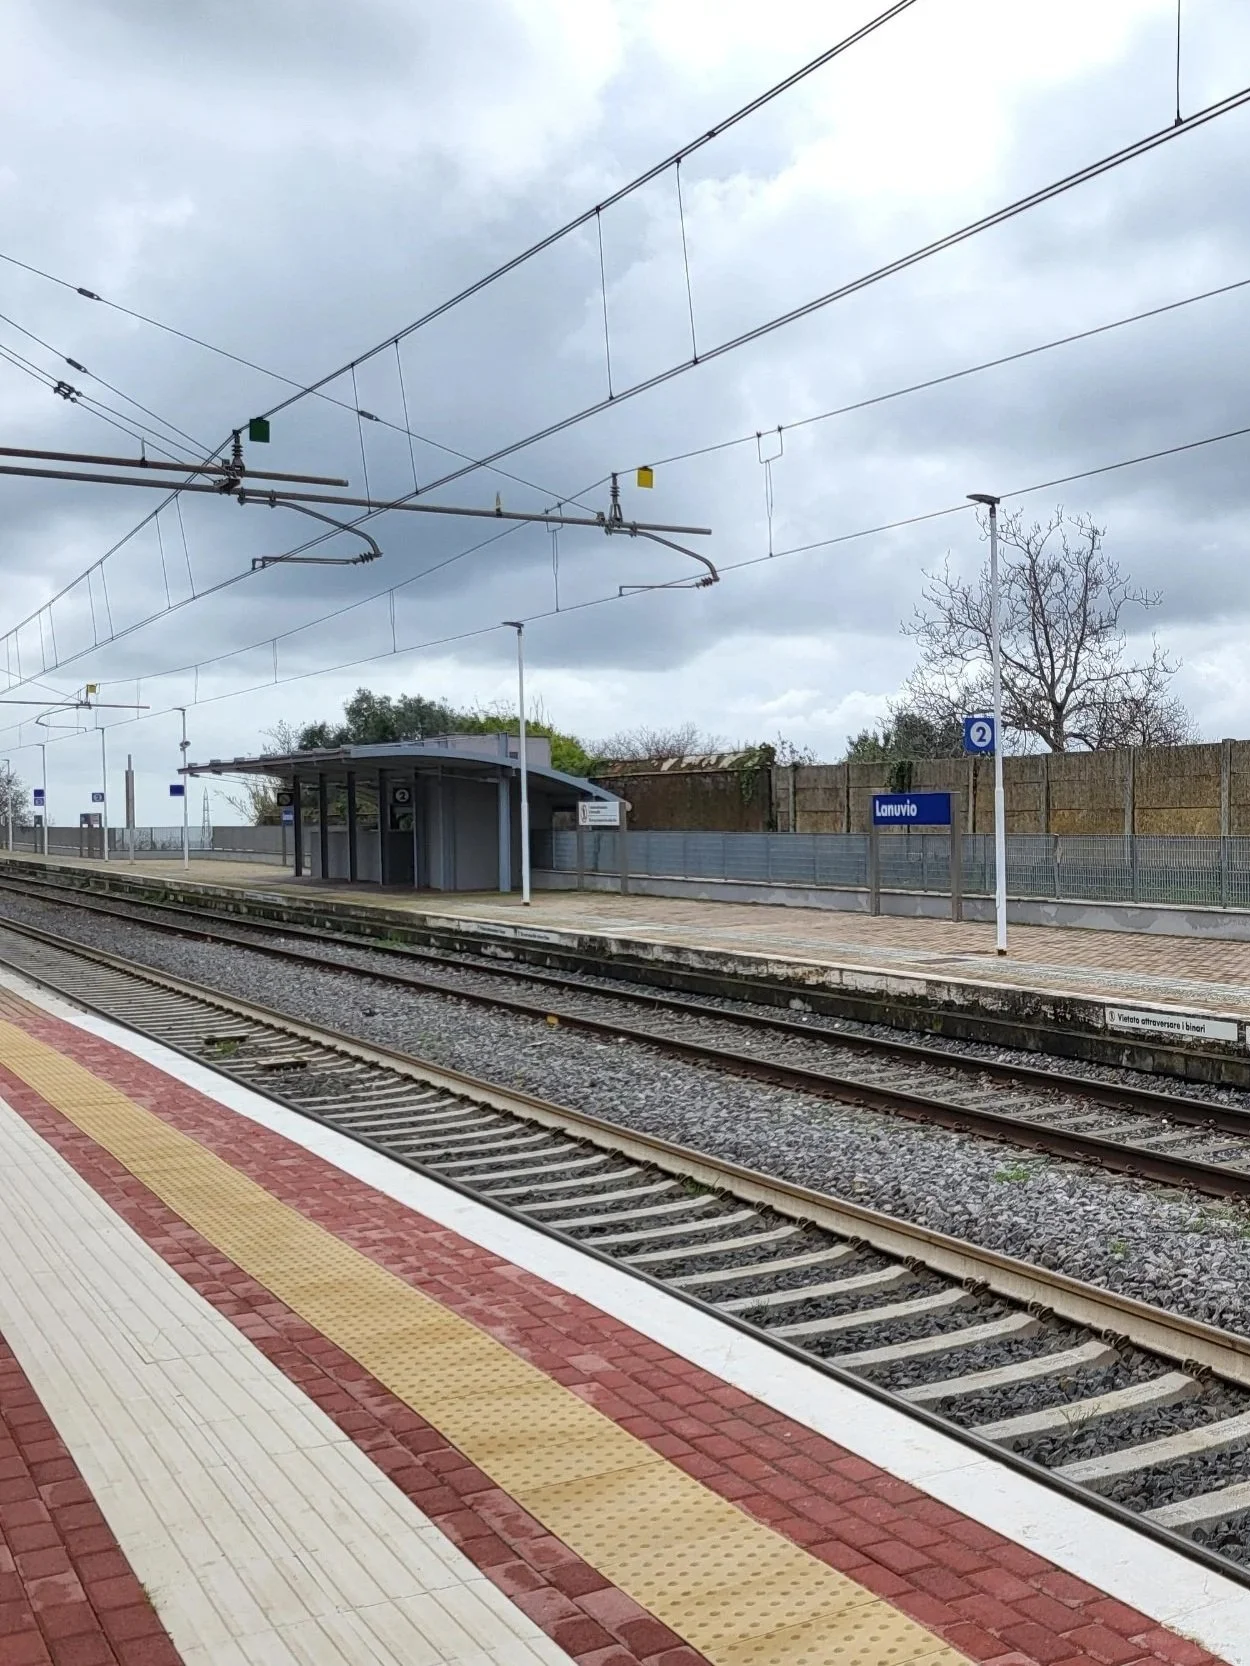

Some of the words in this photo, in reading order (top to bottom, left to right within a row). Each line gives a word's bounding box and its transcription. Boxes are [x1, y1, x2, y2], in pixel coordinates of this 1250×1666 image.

[976, 726, 987, 742] 2
[875, 799, 918, 817] Lanuvio
[1117, 1013, 1140, 1024] Vietato
[1141, 1018, 1181, 1030] attraversare
[1186, 1022, 1206, 1033] binari
